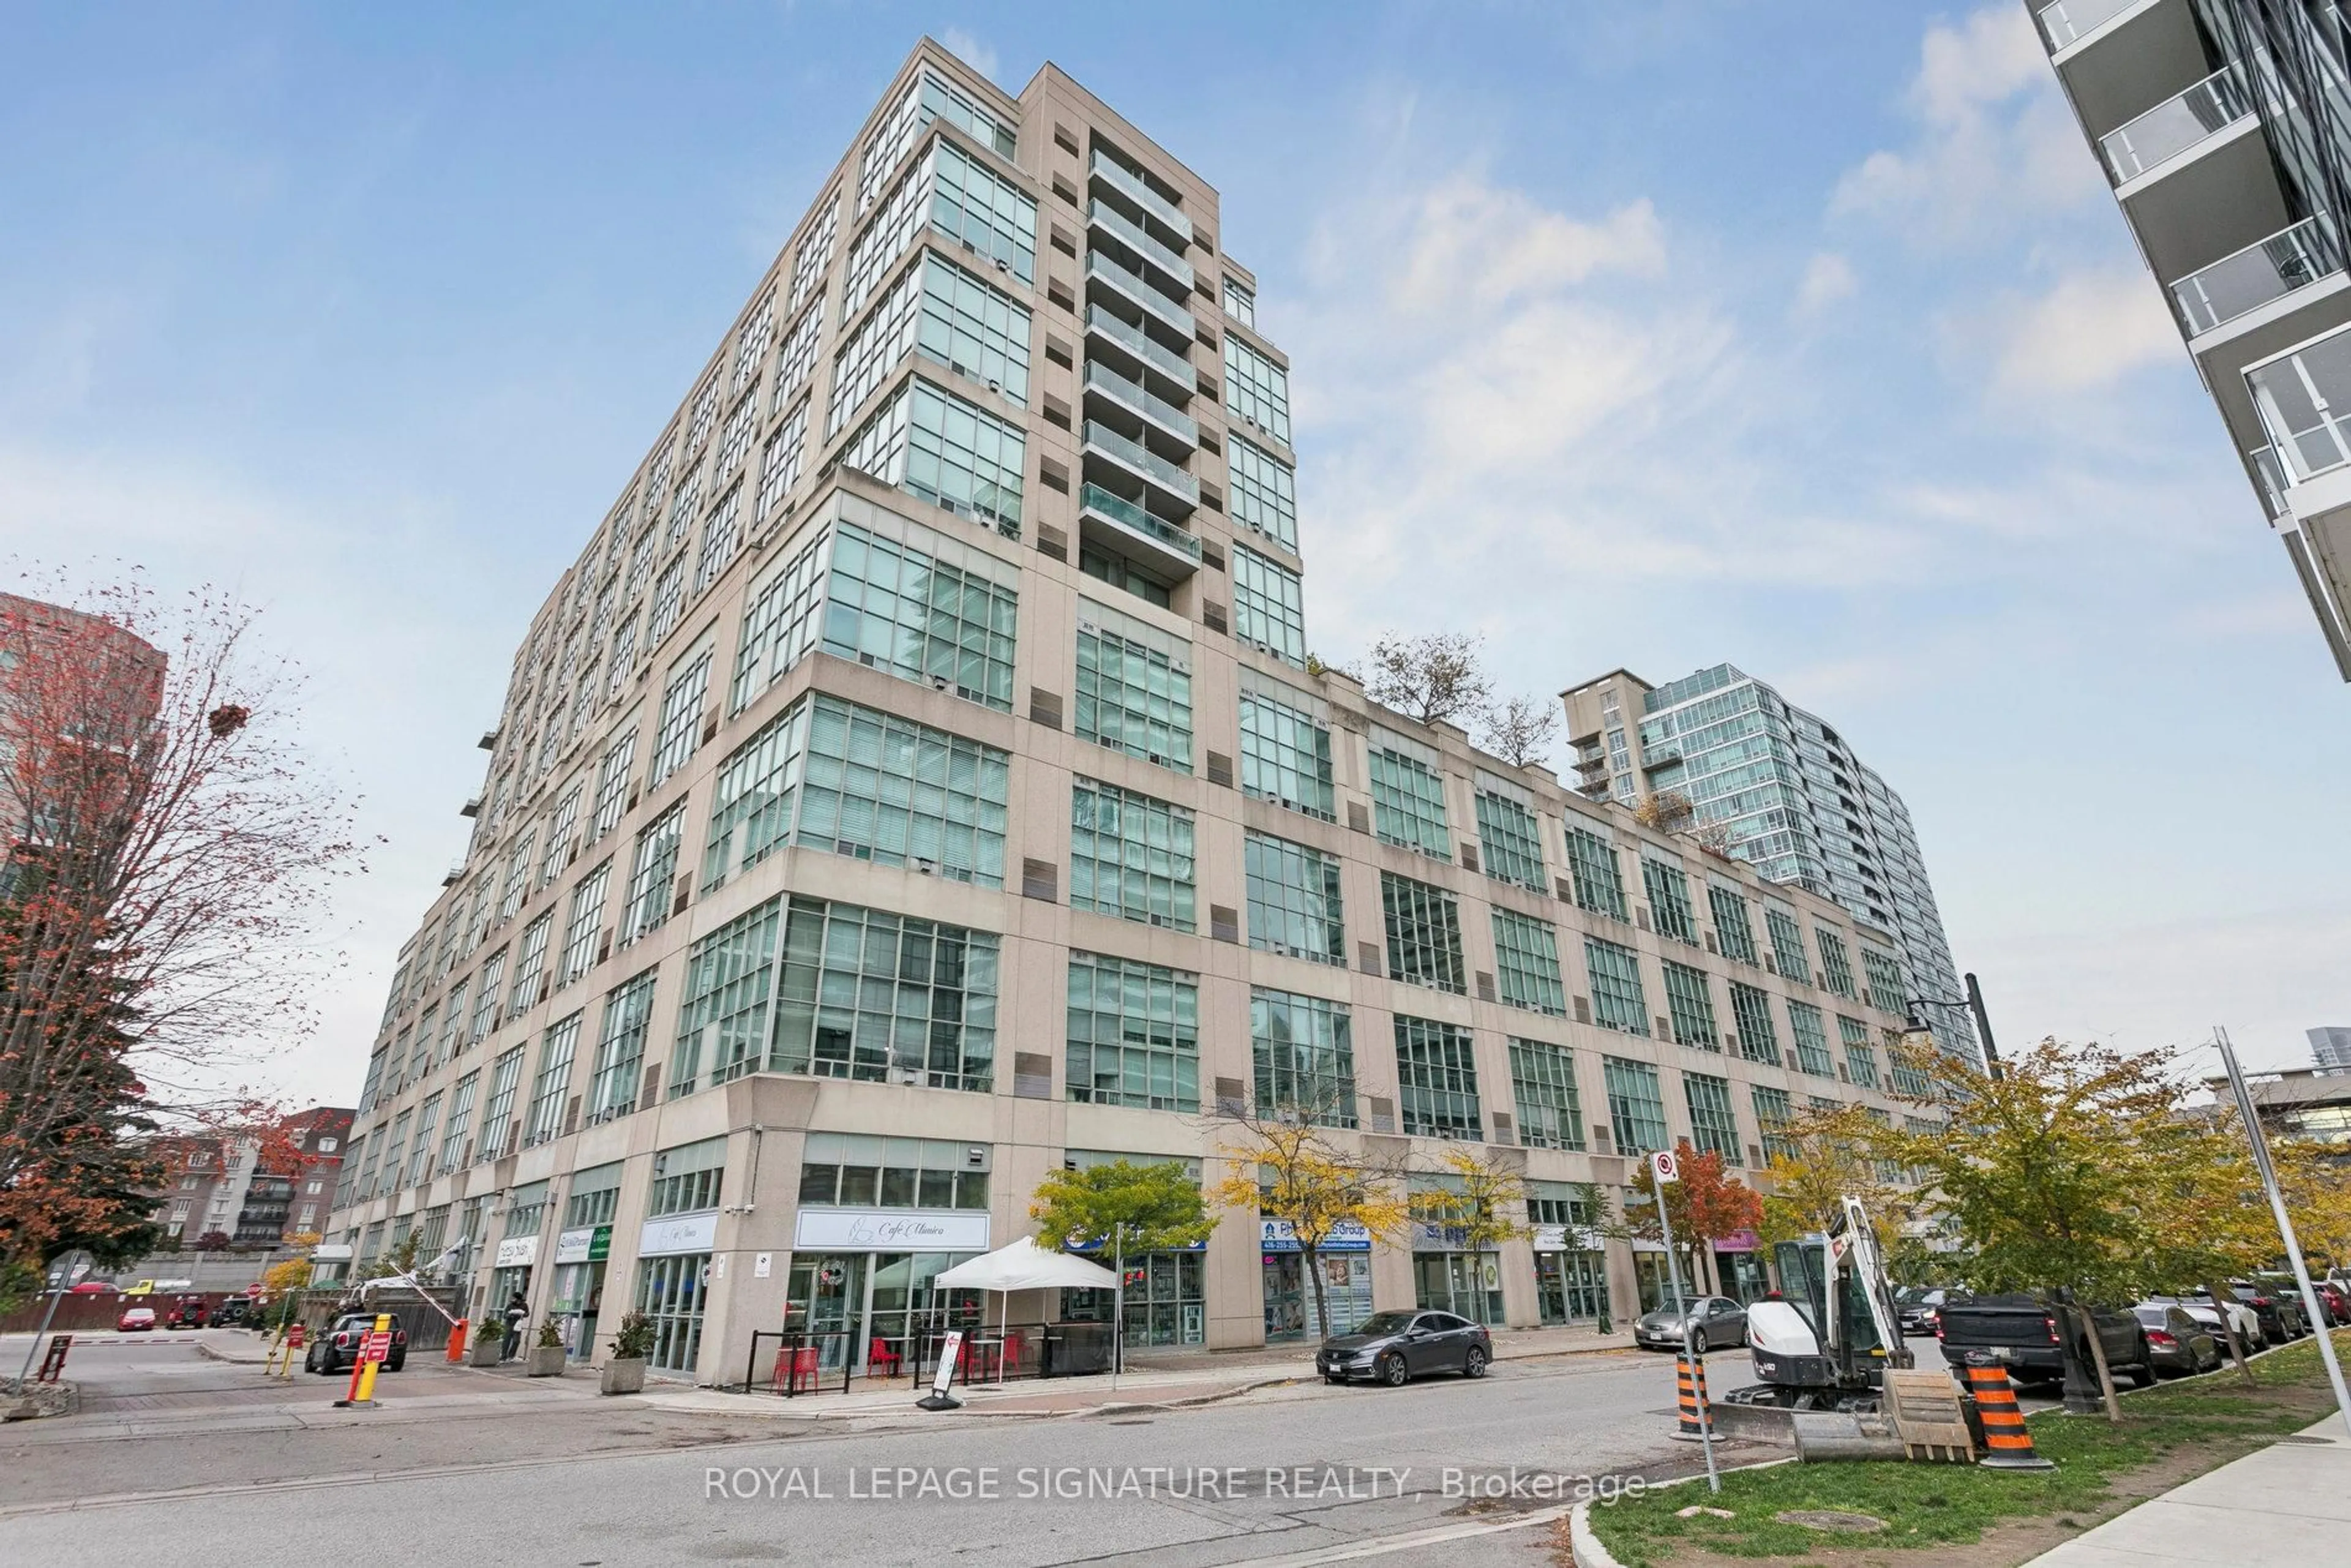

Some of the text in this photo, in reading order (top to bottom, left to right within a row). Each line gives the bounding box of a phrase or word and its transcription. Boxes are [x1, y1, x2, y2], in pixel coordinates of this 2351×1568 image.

[879, 1219, 944, 1244] Café Mimico
[1187, 1307, 1200, 1317] ATM
